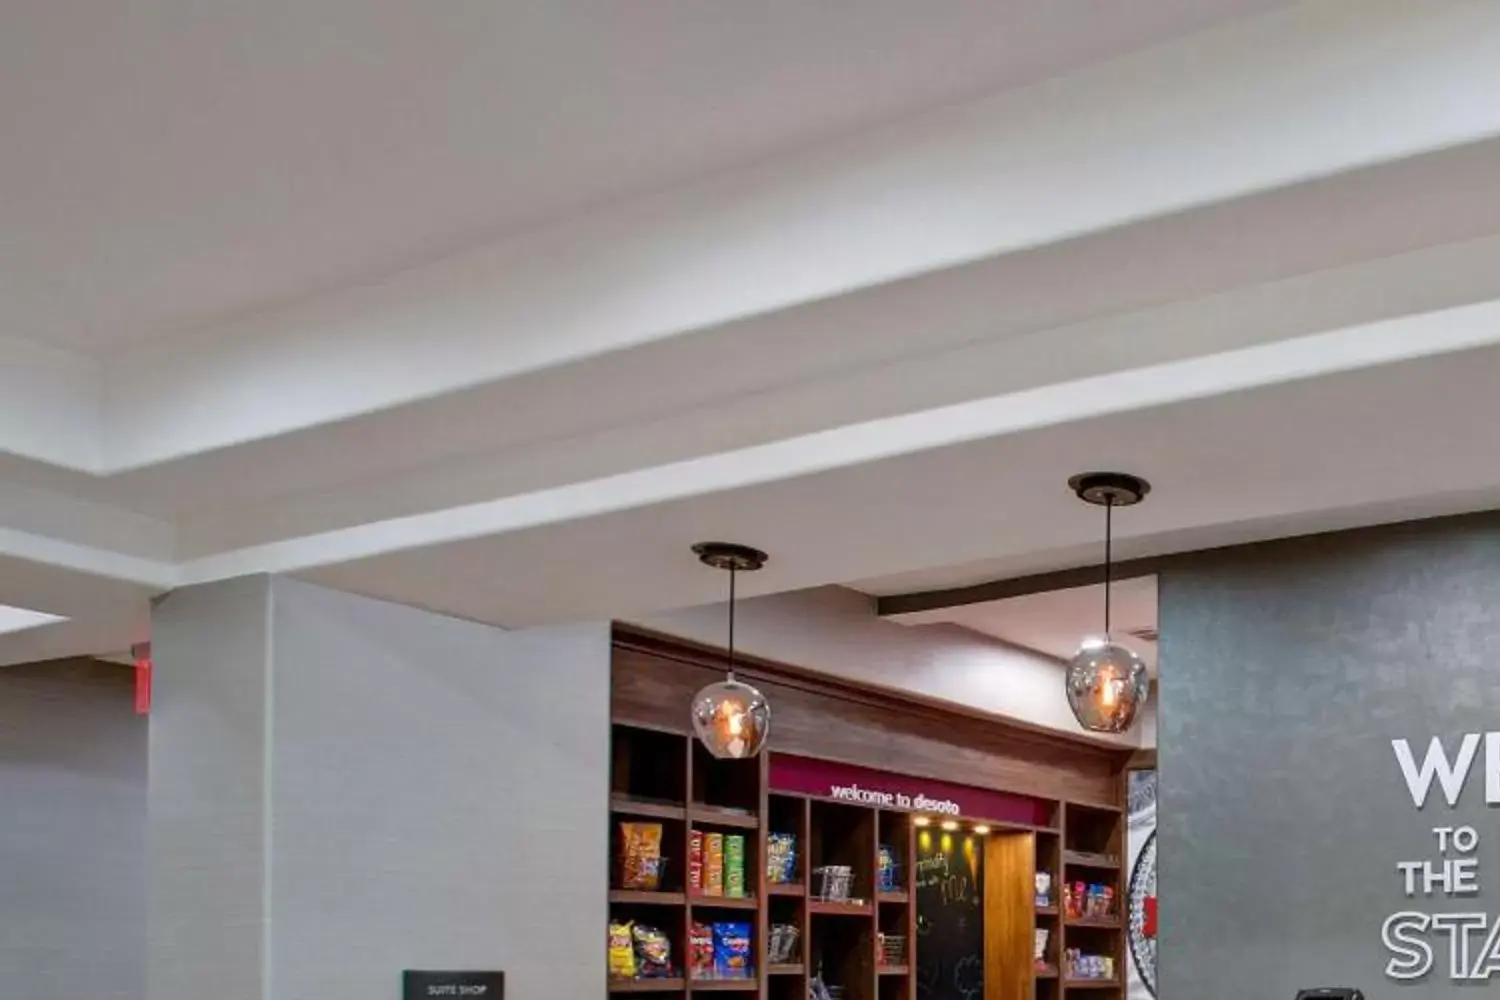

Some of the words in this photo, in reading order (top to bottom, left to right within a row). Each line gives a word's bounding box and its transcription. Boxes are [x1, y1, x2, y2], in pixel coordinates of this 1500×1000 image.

[831, 783, 893, 806] welcome
[896, 792, 911, 808] to
[914, 793, 960, 816] desoto
[1432, 825, 1479, 853] TO
[1396, 859, 1479, 895] THE
[427, 985, 457, 996] SUITE
[459, 984, 488, 996] SHOP
